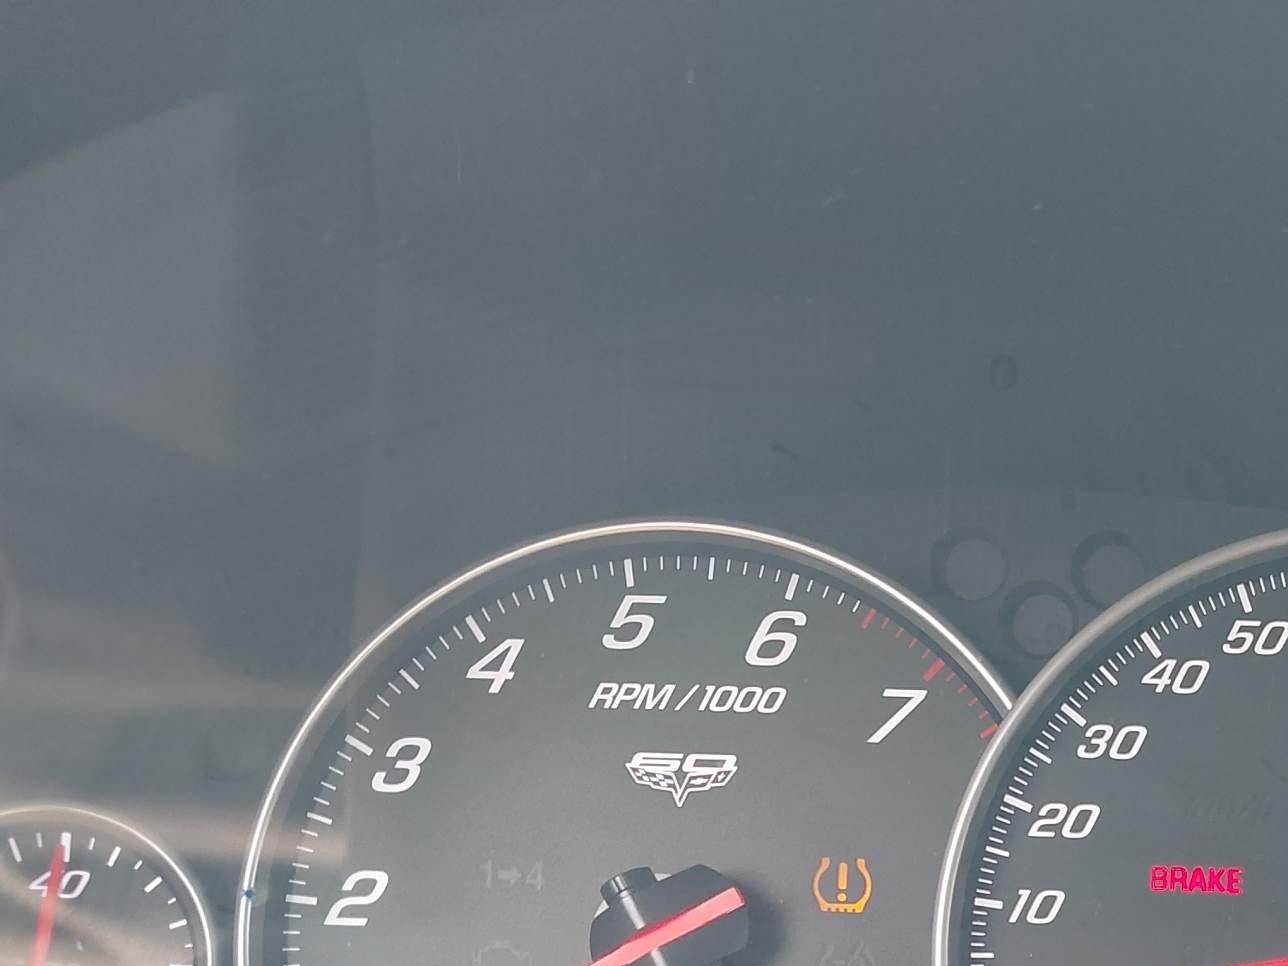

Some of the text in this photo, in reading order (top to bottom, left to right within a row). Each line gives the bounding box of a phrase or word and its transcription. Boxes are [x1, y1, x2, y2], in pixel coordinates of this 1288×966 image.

[602, 594, 668, 650] 5
[744, 610, 807, 666] 6
[465, 638, 525, 694] 4
[1141, 658, 1210, 695] 40
[866, 688, 928, 744] 7
[1076, 724, 1148, 760] 30
[371, 736, 432, 793] 3
[1027, 803, 1101, 839] 20
[323, 869, 389, 927] 2
[1008, 889, 1066, 924] 10
[1150, 865, 1241, 895] BRAKE
